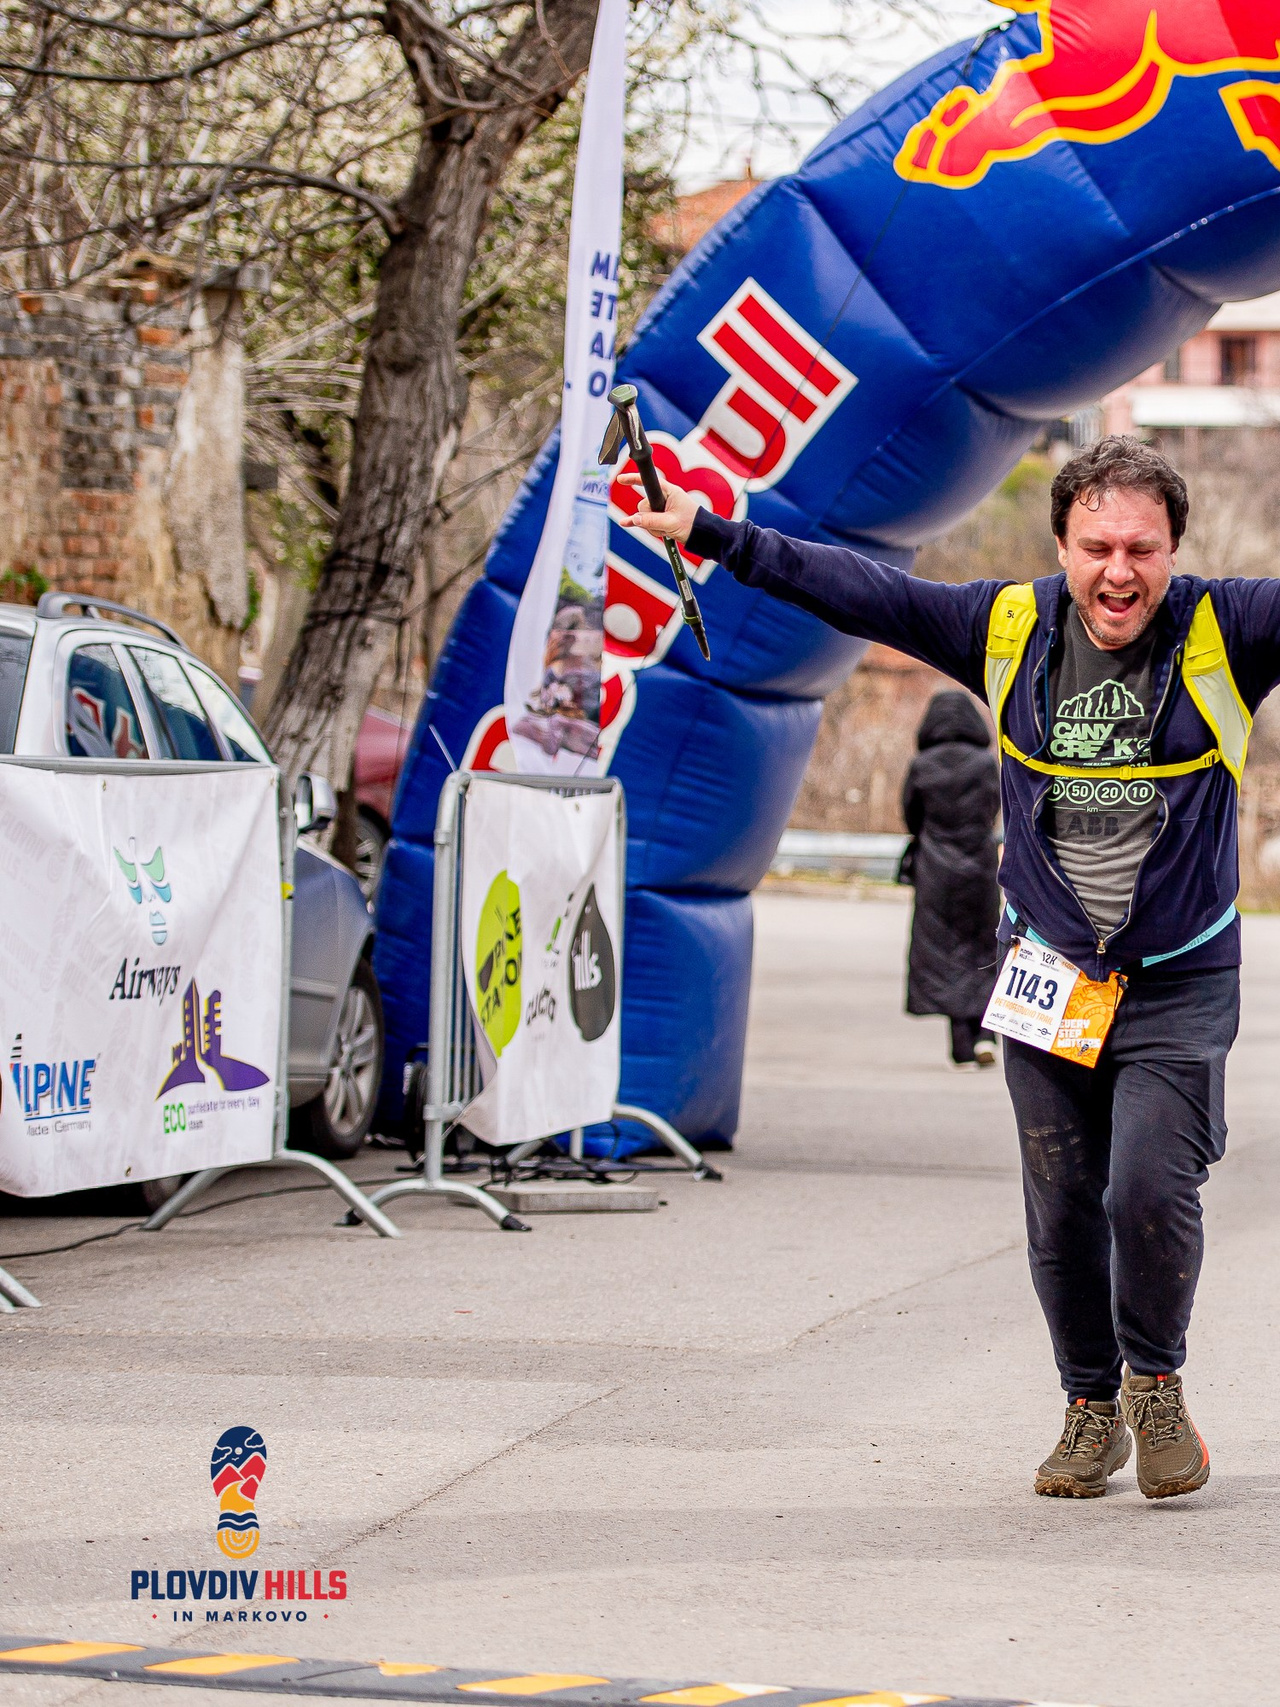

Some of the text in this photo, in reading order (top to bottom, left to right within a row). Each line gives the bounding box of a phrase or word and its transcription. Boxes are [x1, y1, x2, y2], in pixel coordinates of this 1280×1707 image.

[606, 292, 843, 570] Bull
[1072, 785, 1088, 797] 50
[1101, 786, 1118, 799] 20
[1132, 786, 1148, 798] 10
[108, 957, 181, 1007] Airways
[1005, 965, 1058, 1011] 1143
[163, 1102, 186, 1134] ECO
